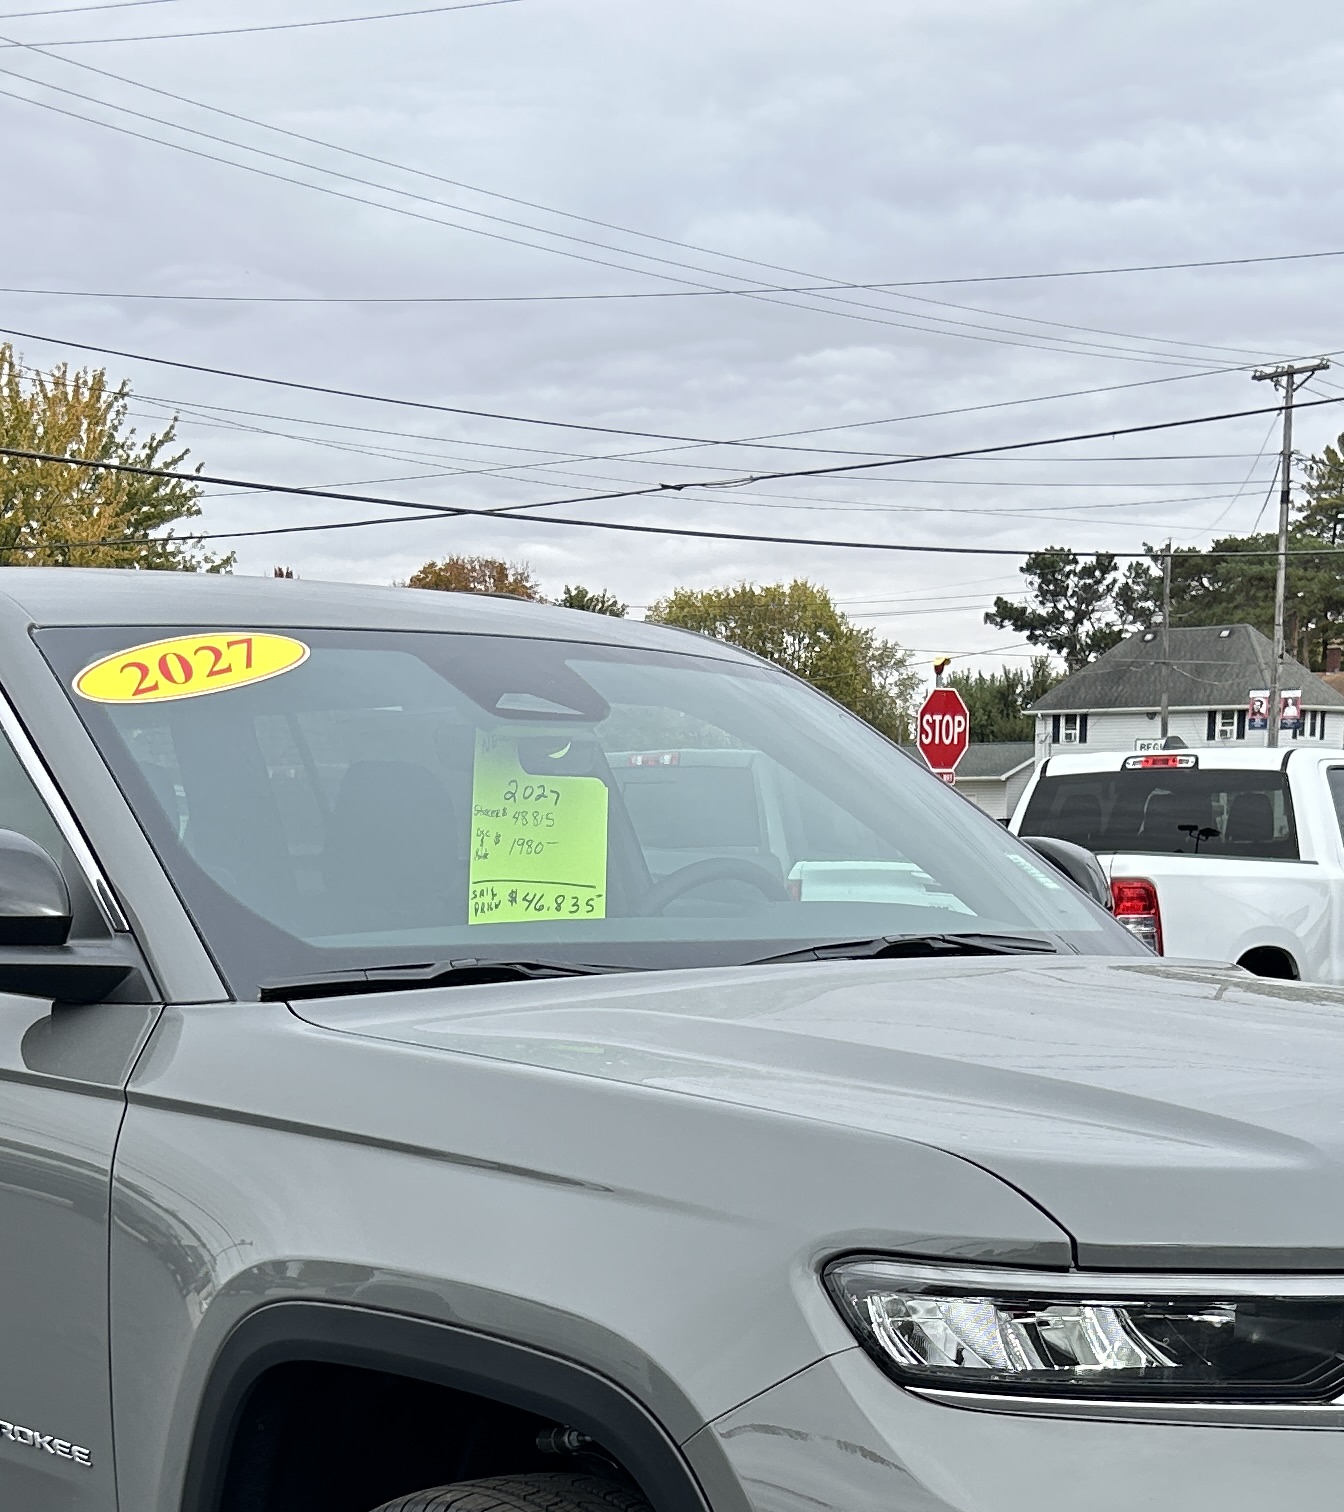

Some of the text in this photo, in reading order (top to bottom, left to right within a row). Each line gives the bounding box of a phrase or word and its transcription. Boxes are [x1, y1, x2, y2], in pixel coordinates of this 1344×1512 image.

[119, 637, 253, 697] 2027
[921, 713, 966, 745] STOP
[503, 780, 561, 806] 2027
[512, 810, 555, 828] 48815
